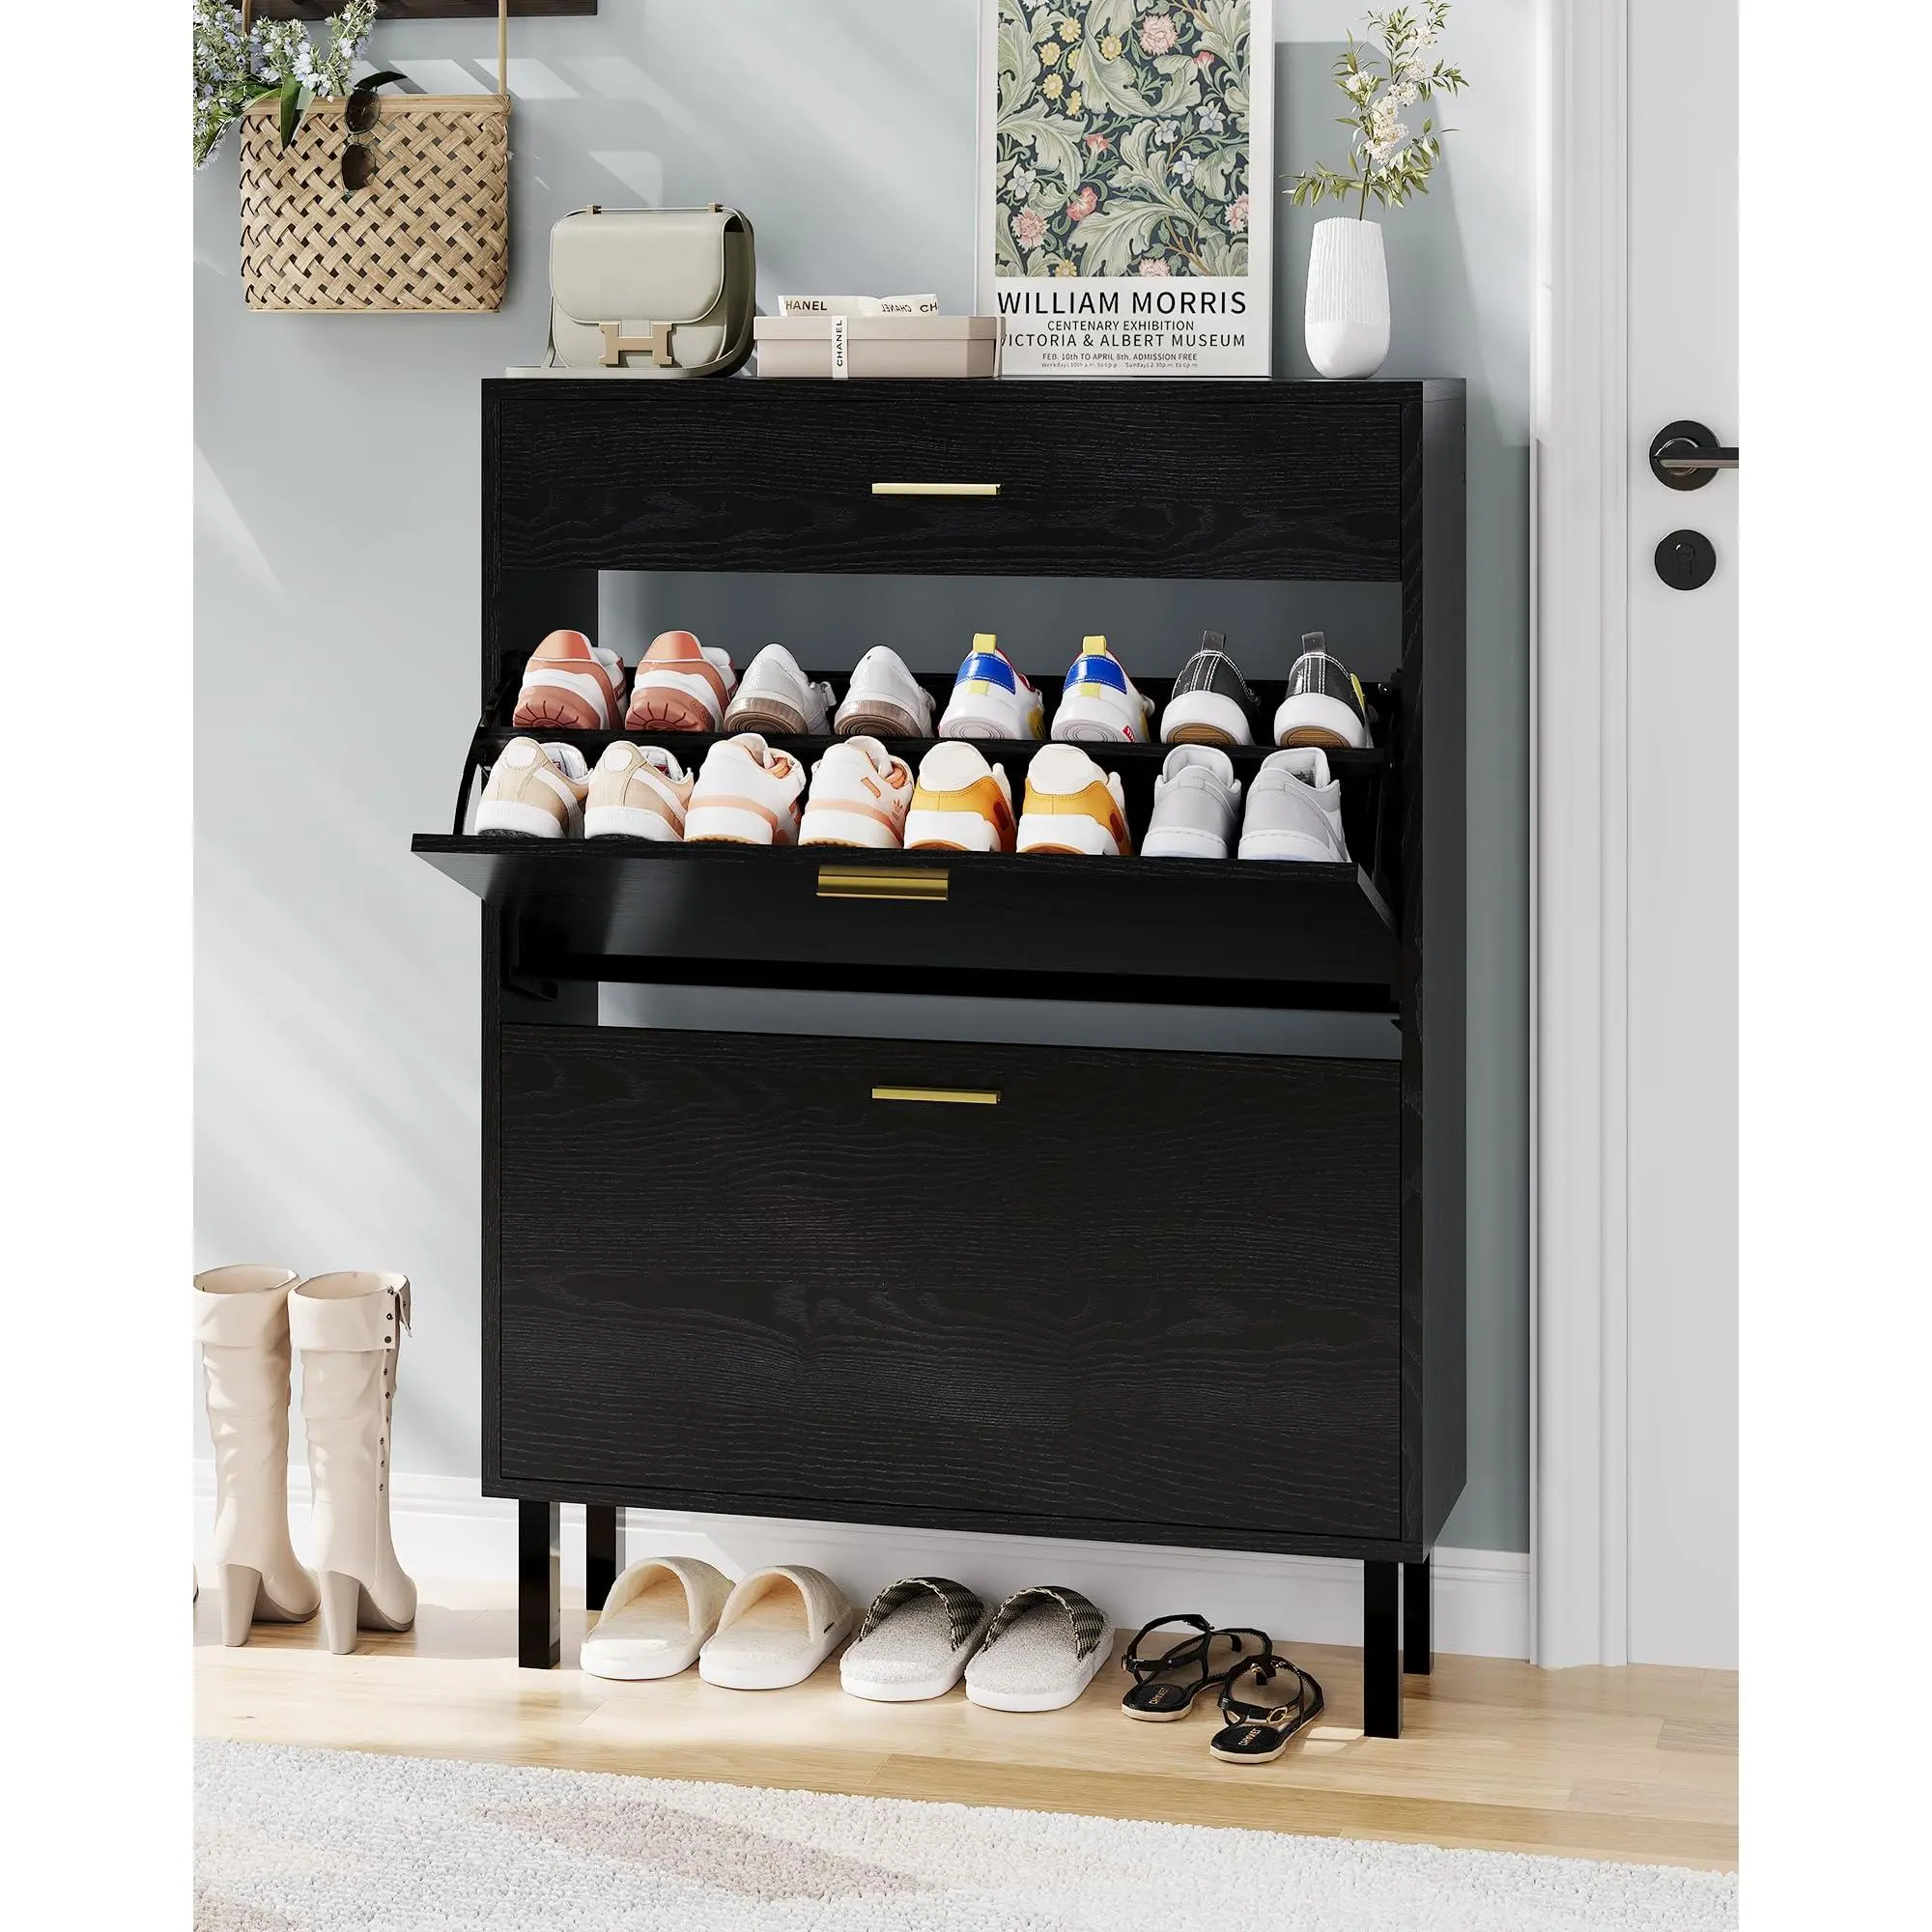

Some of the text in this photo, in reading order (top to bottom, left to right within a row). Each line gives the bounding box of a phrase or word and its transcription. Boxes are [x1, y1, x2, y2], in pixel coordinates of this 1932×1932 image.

[785, 300, 828, 311] HANEL
[997, 292, 1247, 314] WILLIAM MORRIS
[1047, 320, 1194, 331] CENTENARY EXHIBITION
[1083, 333, 1094, 347] &
[1099, 333, 1164, 347] ALBERT
[1172, 333, 1245, 347] MUSEUM
[1042, 353, 1059, 361] FEB.
[1062, 353, 1078, 361] 10th
[1080, 353, 1091, 361] TO
[1093, 353, 1114, 361] APRIL
[1132, 353, 1177, 361] ADMISSION
[1178, 353, 1198, 361] FREE
